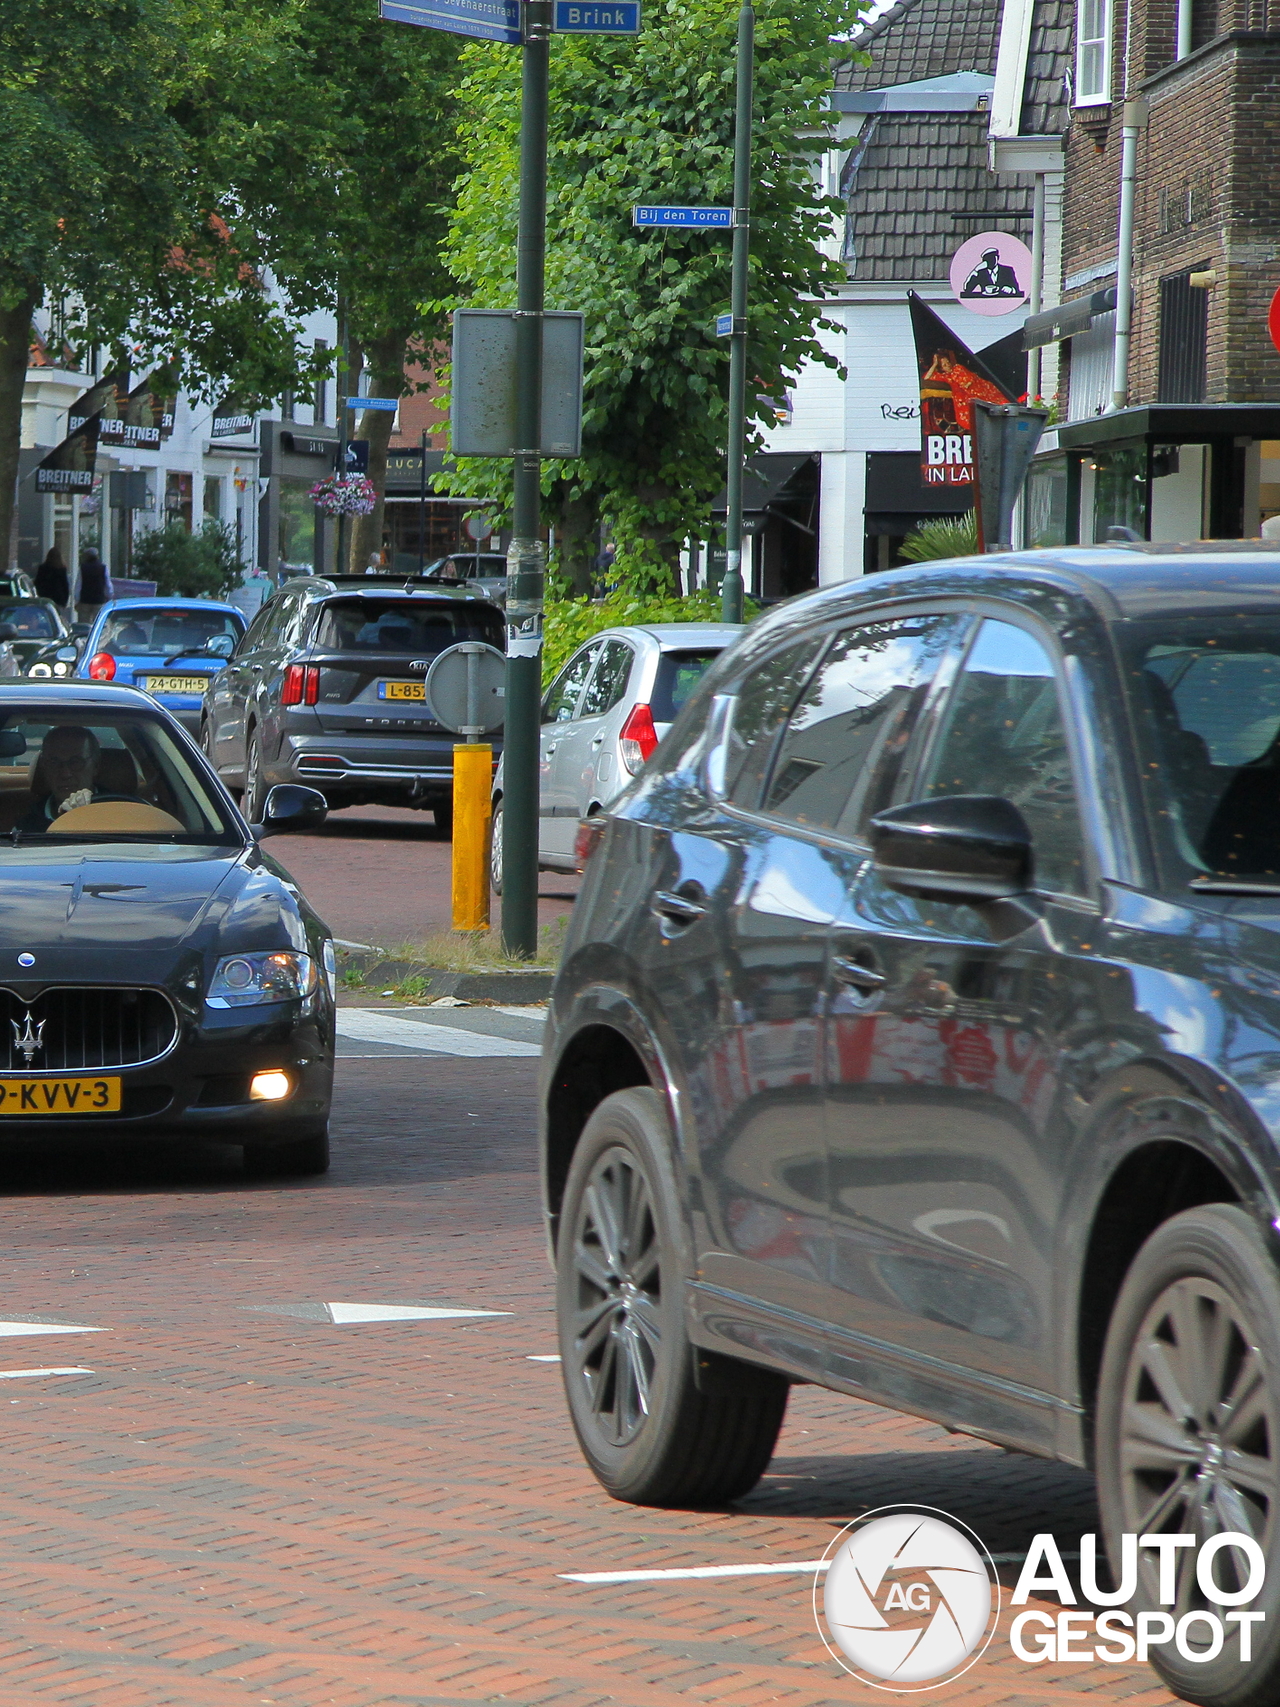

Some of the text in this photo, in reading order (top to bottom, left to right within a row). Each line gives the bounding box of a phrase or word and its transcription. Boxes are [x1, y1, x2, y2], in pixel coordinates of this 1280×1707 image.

[568, 8, 625, 25] Brink
[640, 209, 727, 222] Bij den Toren
[928, 434, 973, 465] BRE
[38, 469, 92, 485] BREITNER
[928, 468, 945, 482] IN
[413, 662, 428, 671] KIA
[150, 678, 204, 690] 24-GTH-5
